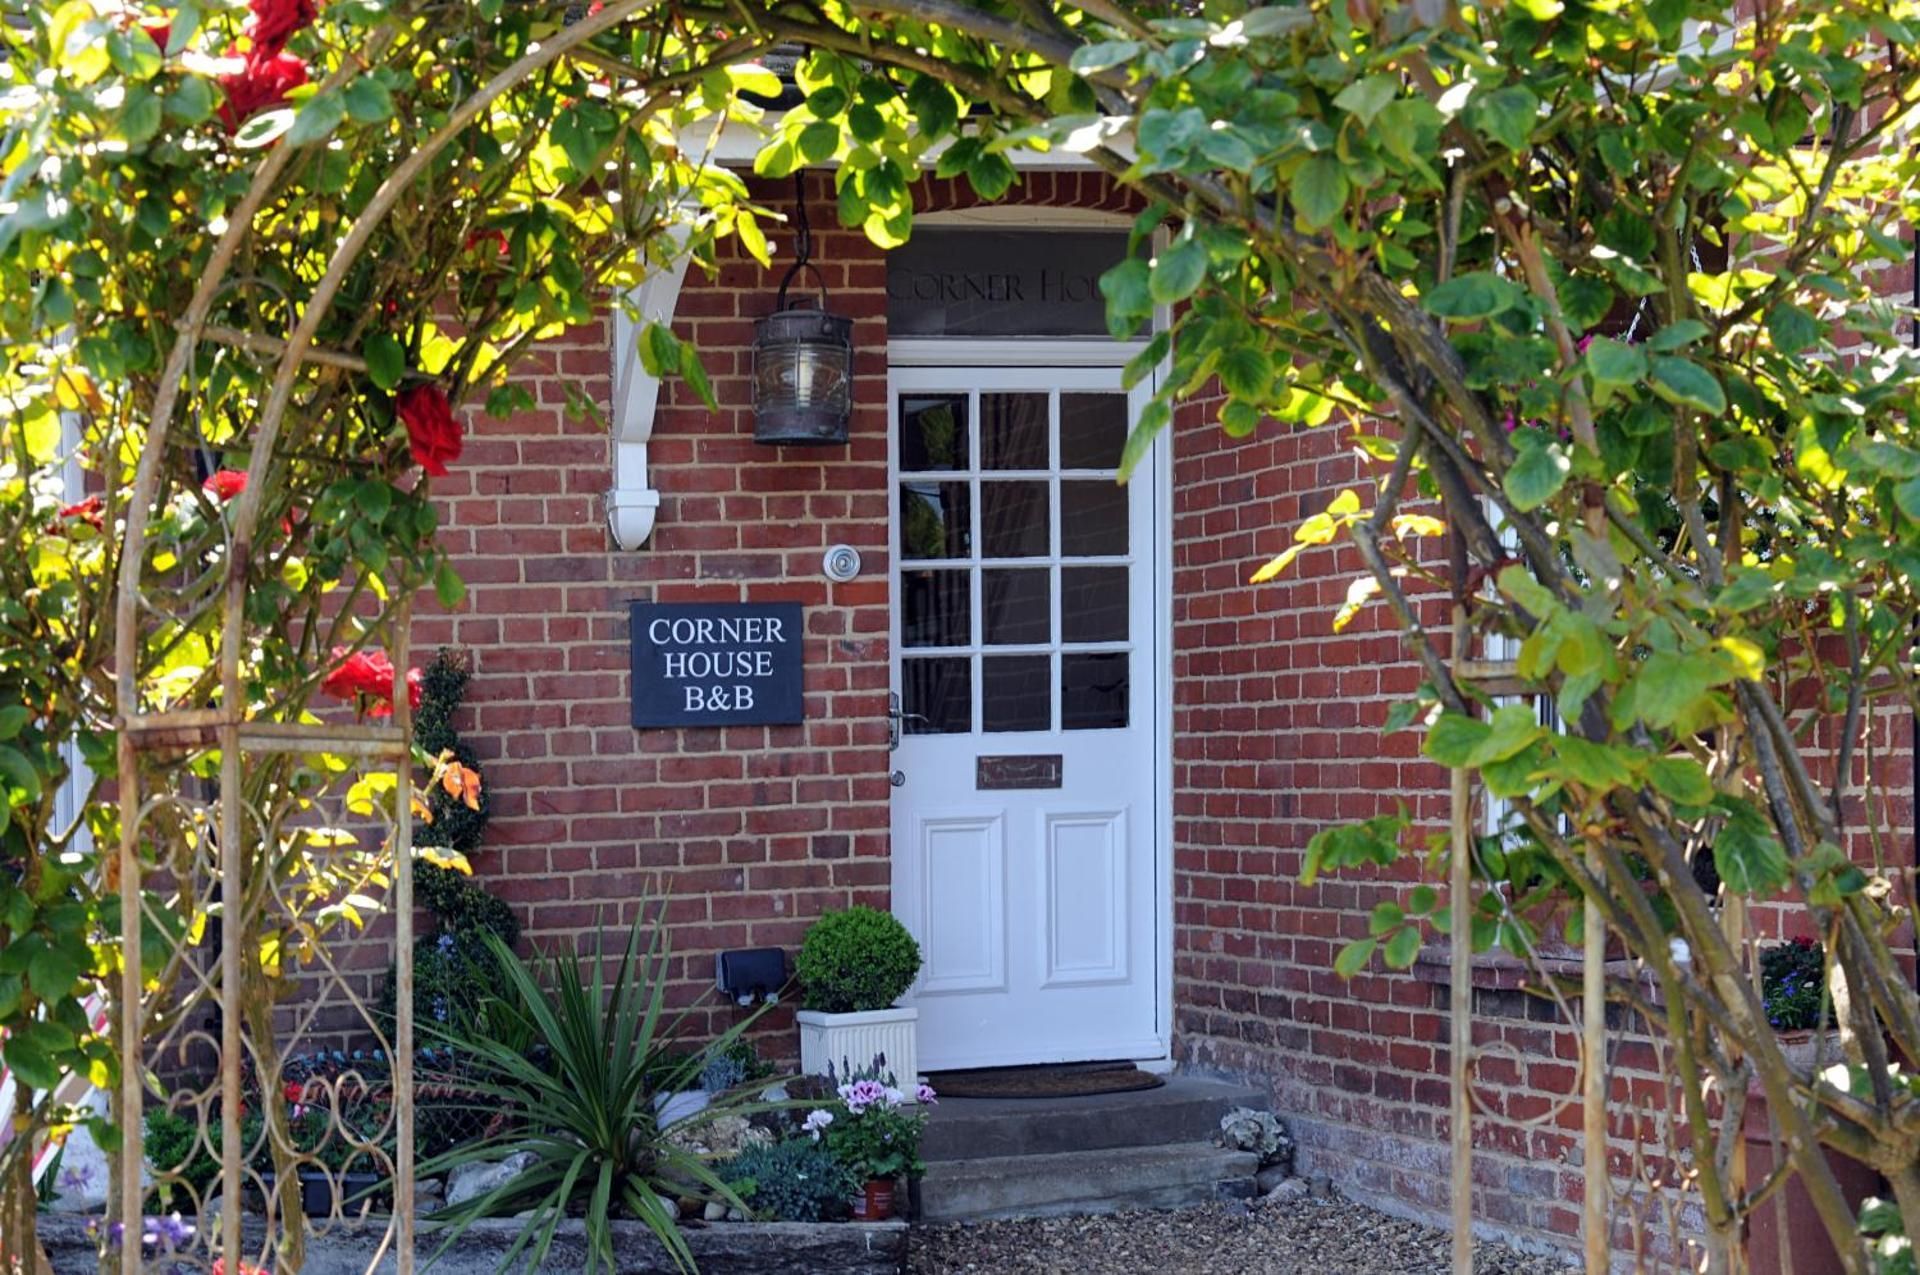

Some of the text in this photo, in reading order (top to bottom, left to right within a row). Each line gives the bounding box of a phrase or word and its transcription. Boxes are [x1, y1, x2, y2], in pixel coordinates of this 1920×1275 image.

[648, 617, 786, 645] CORNER
[663, 650, 773, 678] HOUSE
[683, 685, 754, 712] B&B
